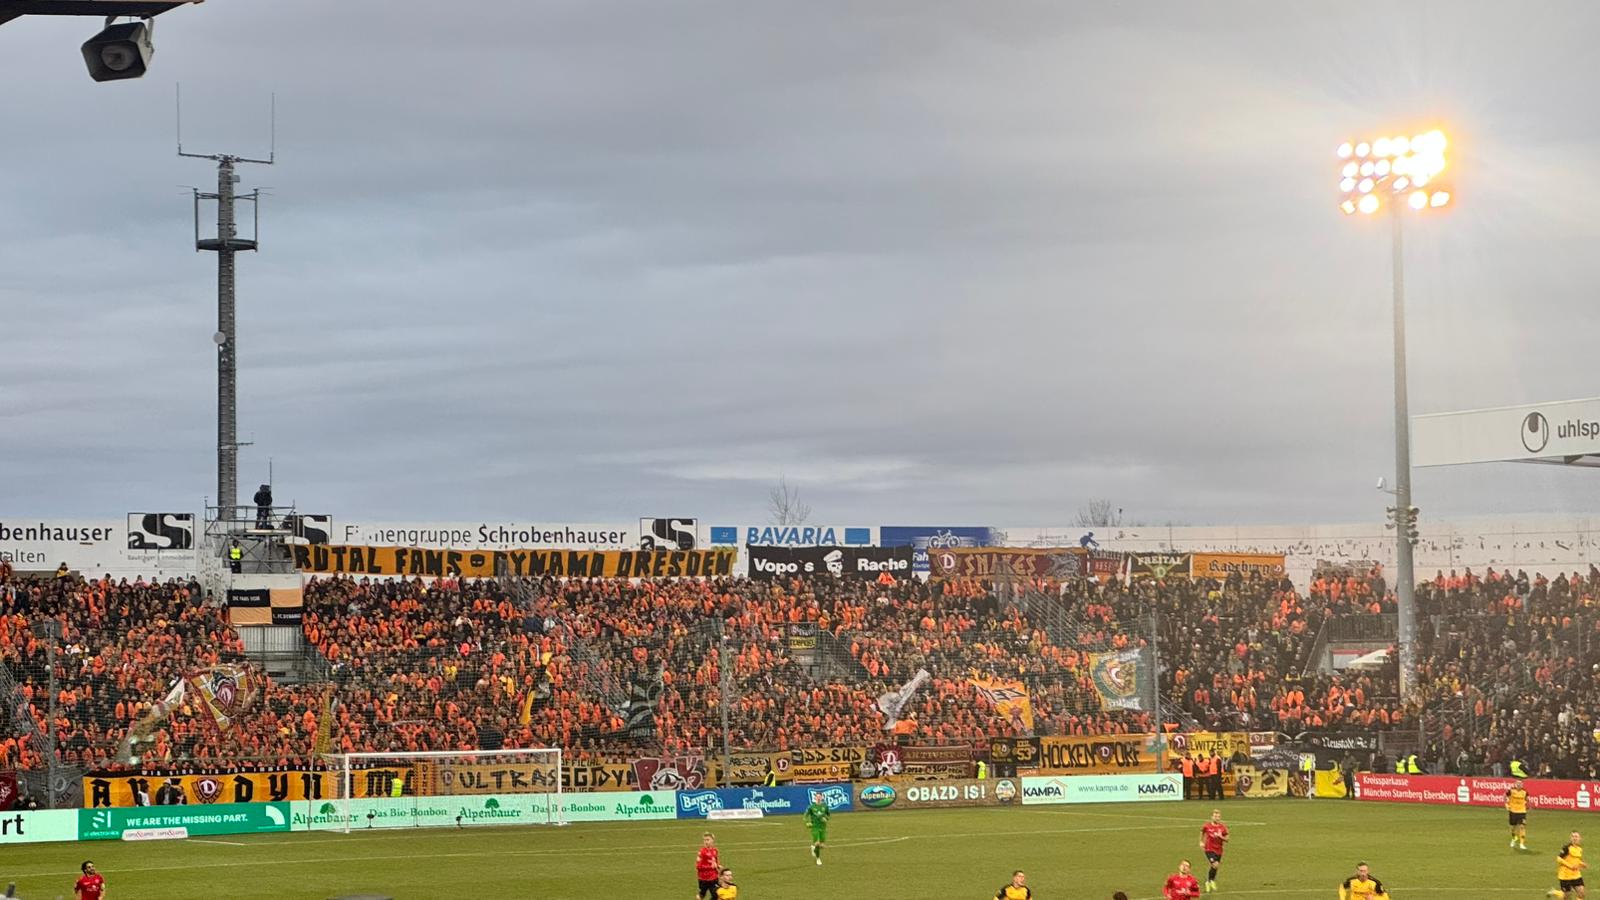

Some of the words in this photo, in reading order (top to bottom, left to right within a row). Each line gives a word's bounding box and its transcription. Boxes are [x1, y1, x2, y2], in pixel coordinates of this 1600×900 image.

[0, 523, 112, 540] benhauser
[478, 524, 627, 544] Schrobenhauser
[748, 527, 836, 545] BAVARIA
[395, 549, 463, 576] FANS
[617, 550, 733, 577] DRESDEN
[857, 557, 908, 571] Rache
[964, 553, 1037, 575] SNAKES
[1138, 556, 1183, 565] FREITAL
[459, 769, 557, 790] ULTRAS
[1363, 776, 1408, 787] Kreissparkasse
[907, 787, 958, 800] OBAZD
[964, 785, 985, 799] IS!
[1023, 787, 1062, 797] KAMPA
[1078, 783, 1129, 792] www.kampa.de
[1138, 784, 1176, 794] KAMPA
[827, 796, 848, 806] Park
[1364, 788, 1391, 797] München
[1424, 790, 1456, 803] Ebersberg
[1539, 795, 1575, 808] Ebersberg
[390, 807, 447, 817] Bio-Bonbon
[460, 807, 521, 819] Alpenbauer
[552, 803, 606, 813] Bo-Bonbon
[615, 802, 675, 817] Alpenbauer
[701, 800, 722, 812] Park
[127, 818, 141, 827] WE
[143, 817, 161, 825] ARE
[163, 816, 181, 825] THE
[182, 814, 221, 824] MISSING
[223, 813, 248, 823] PART.
